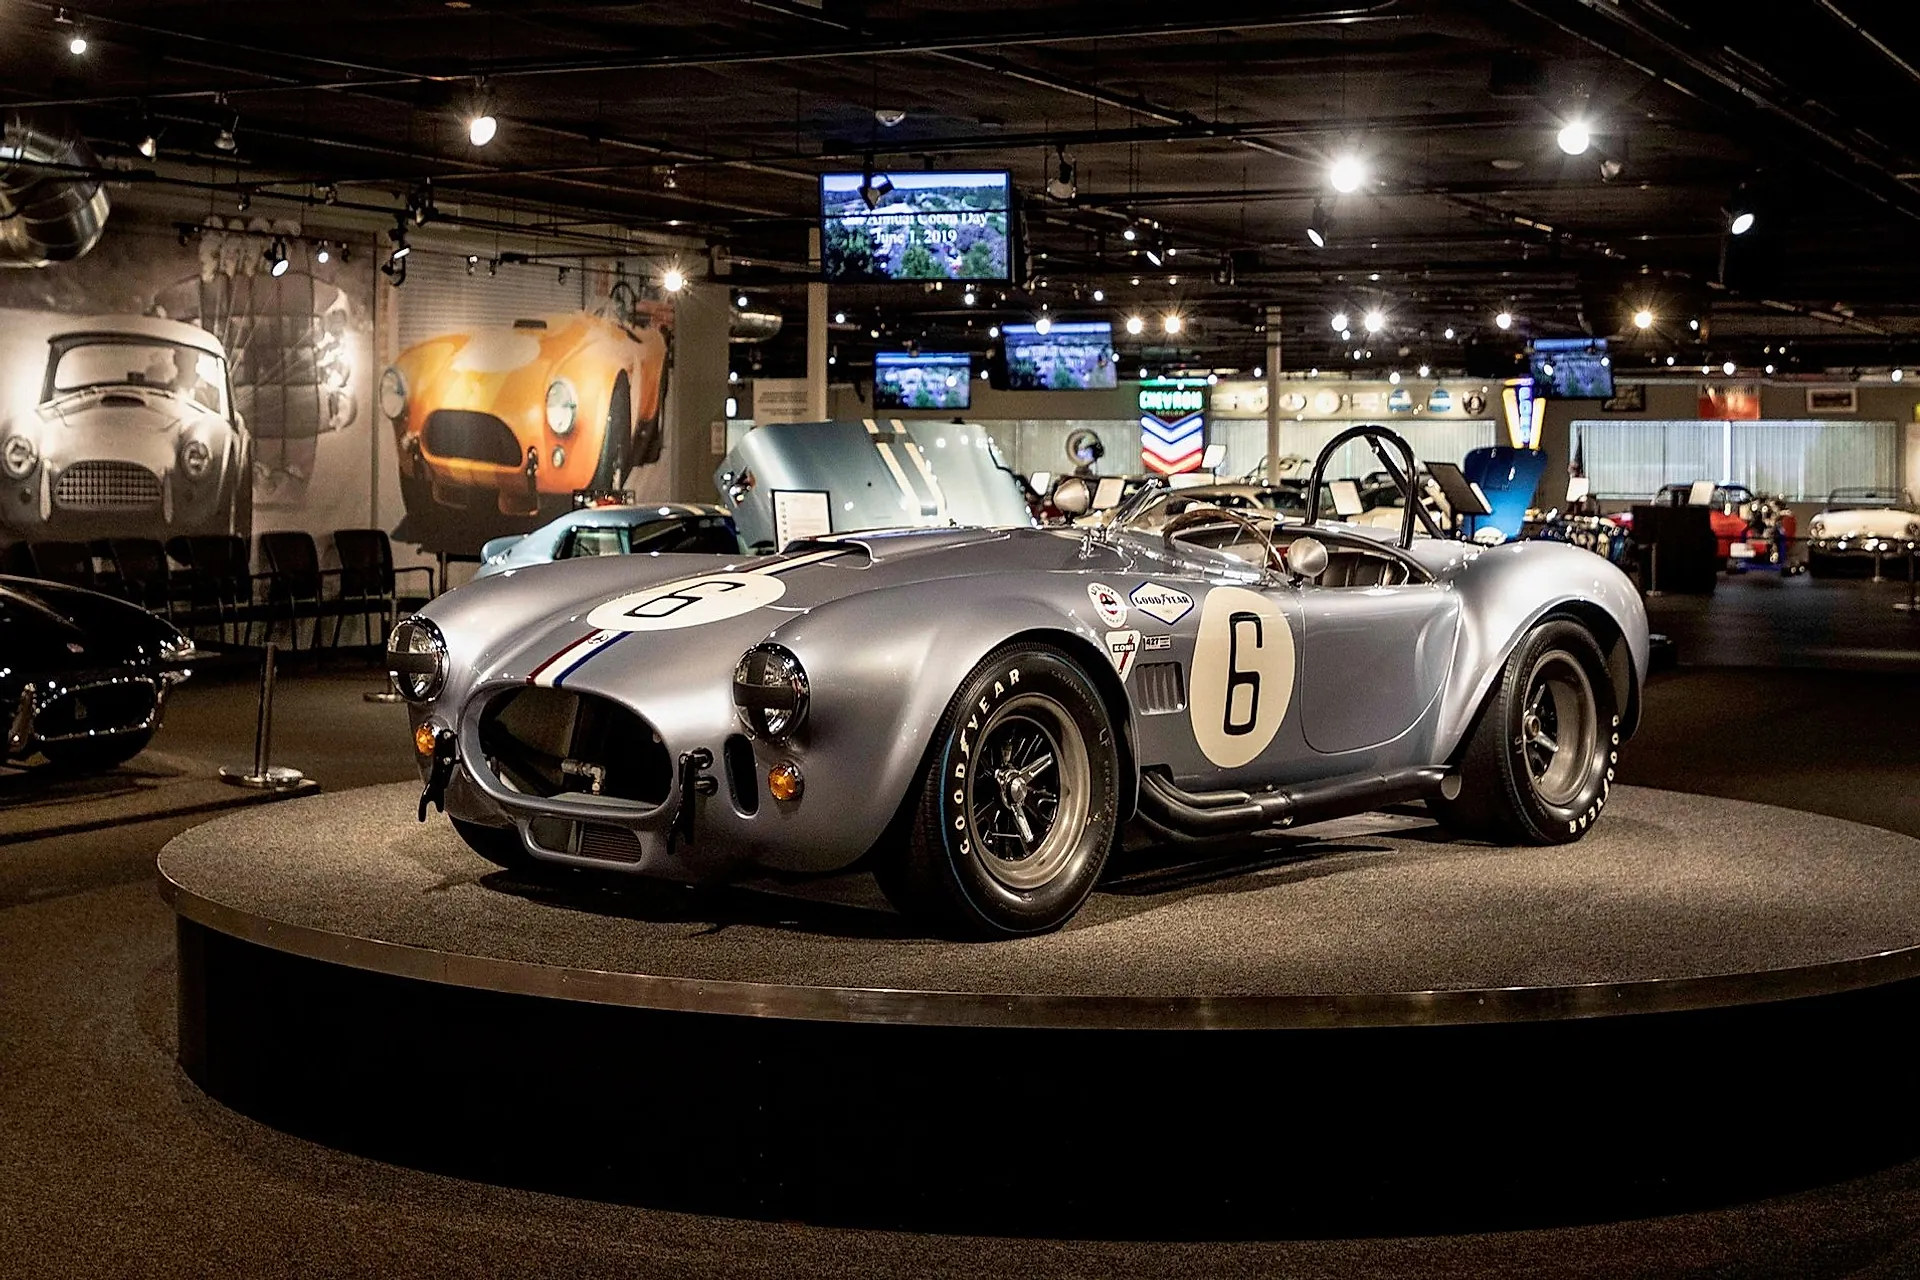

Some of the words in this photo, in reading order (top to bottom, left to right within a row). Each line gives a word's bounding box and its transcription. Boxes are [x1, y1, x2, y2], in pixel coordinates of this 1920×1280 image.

[961, 211, 988, 228] Day
[922, 229, 958, 244] 2019
[622, 581, 746, 618] 6
[1113, 644, 1135, 652] KONI
[1146, 637, 1160, 646] 427
[1223, 611, 1263, 736] 6
